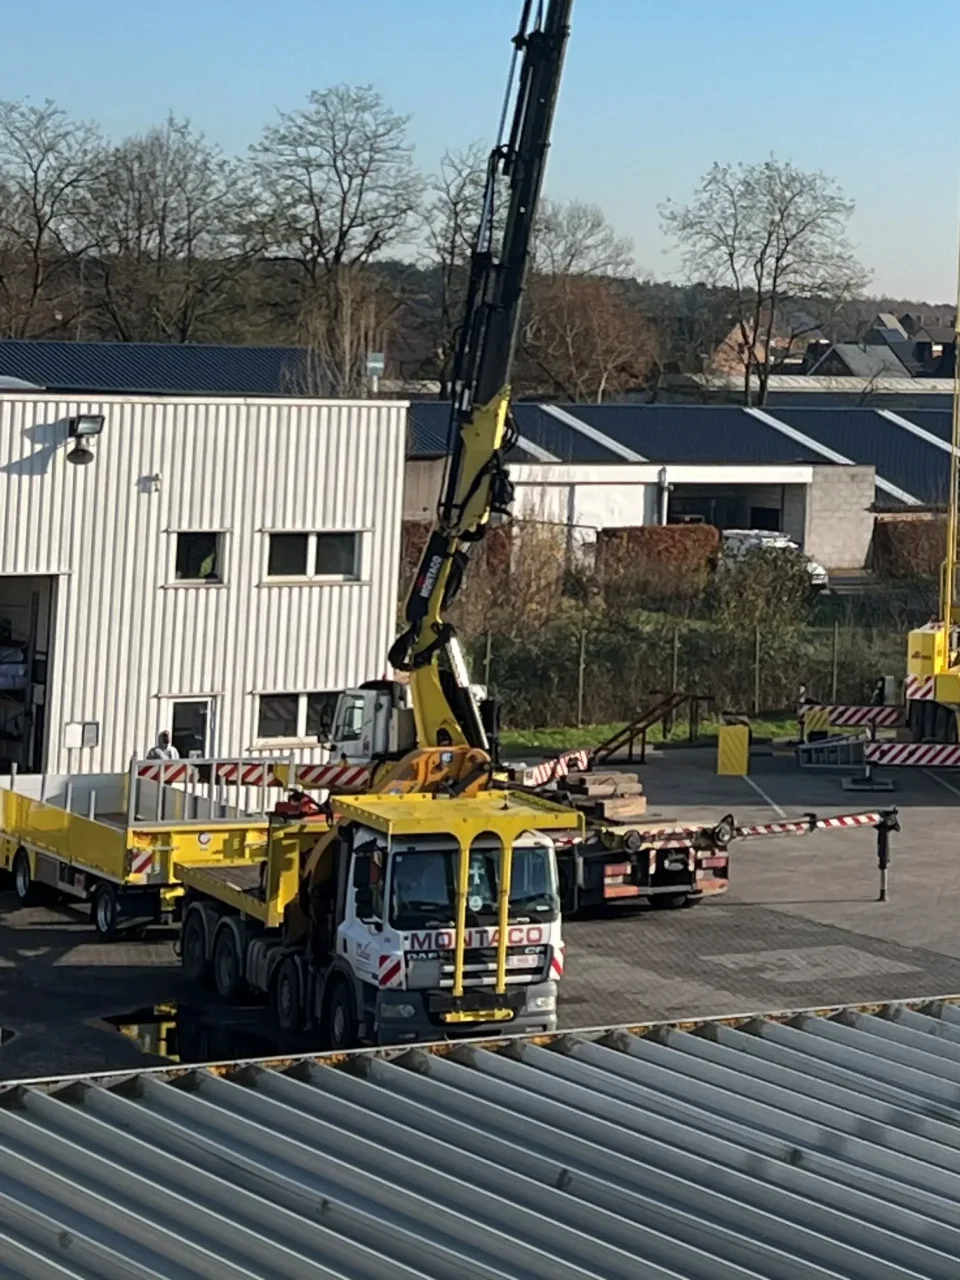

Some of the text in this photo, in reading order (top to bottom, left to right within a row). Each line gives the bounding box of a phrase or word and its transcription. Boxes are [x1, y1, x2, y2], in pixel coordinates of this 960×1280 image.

[420, 555, 442, 597] MONTACO
[411, 927, 543, 950] MONTACO
[406, 952, 438, 962] DAF
